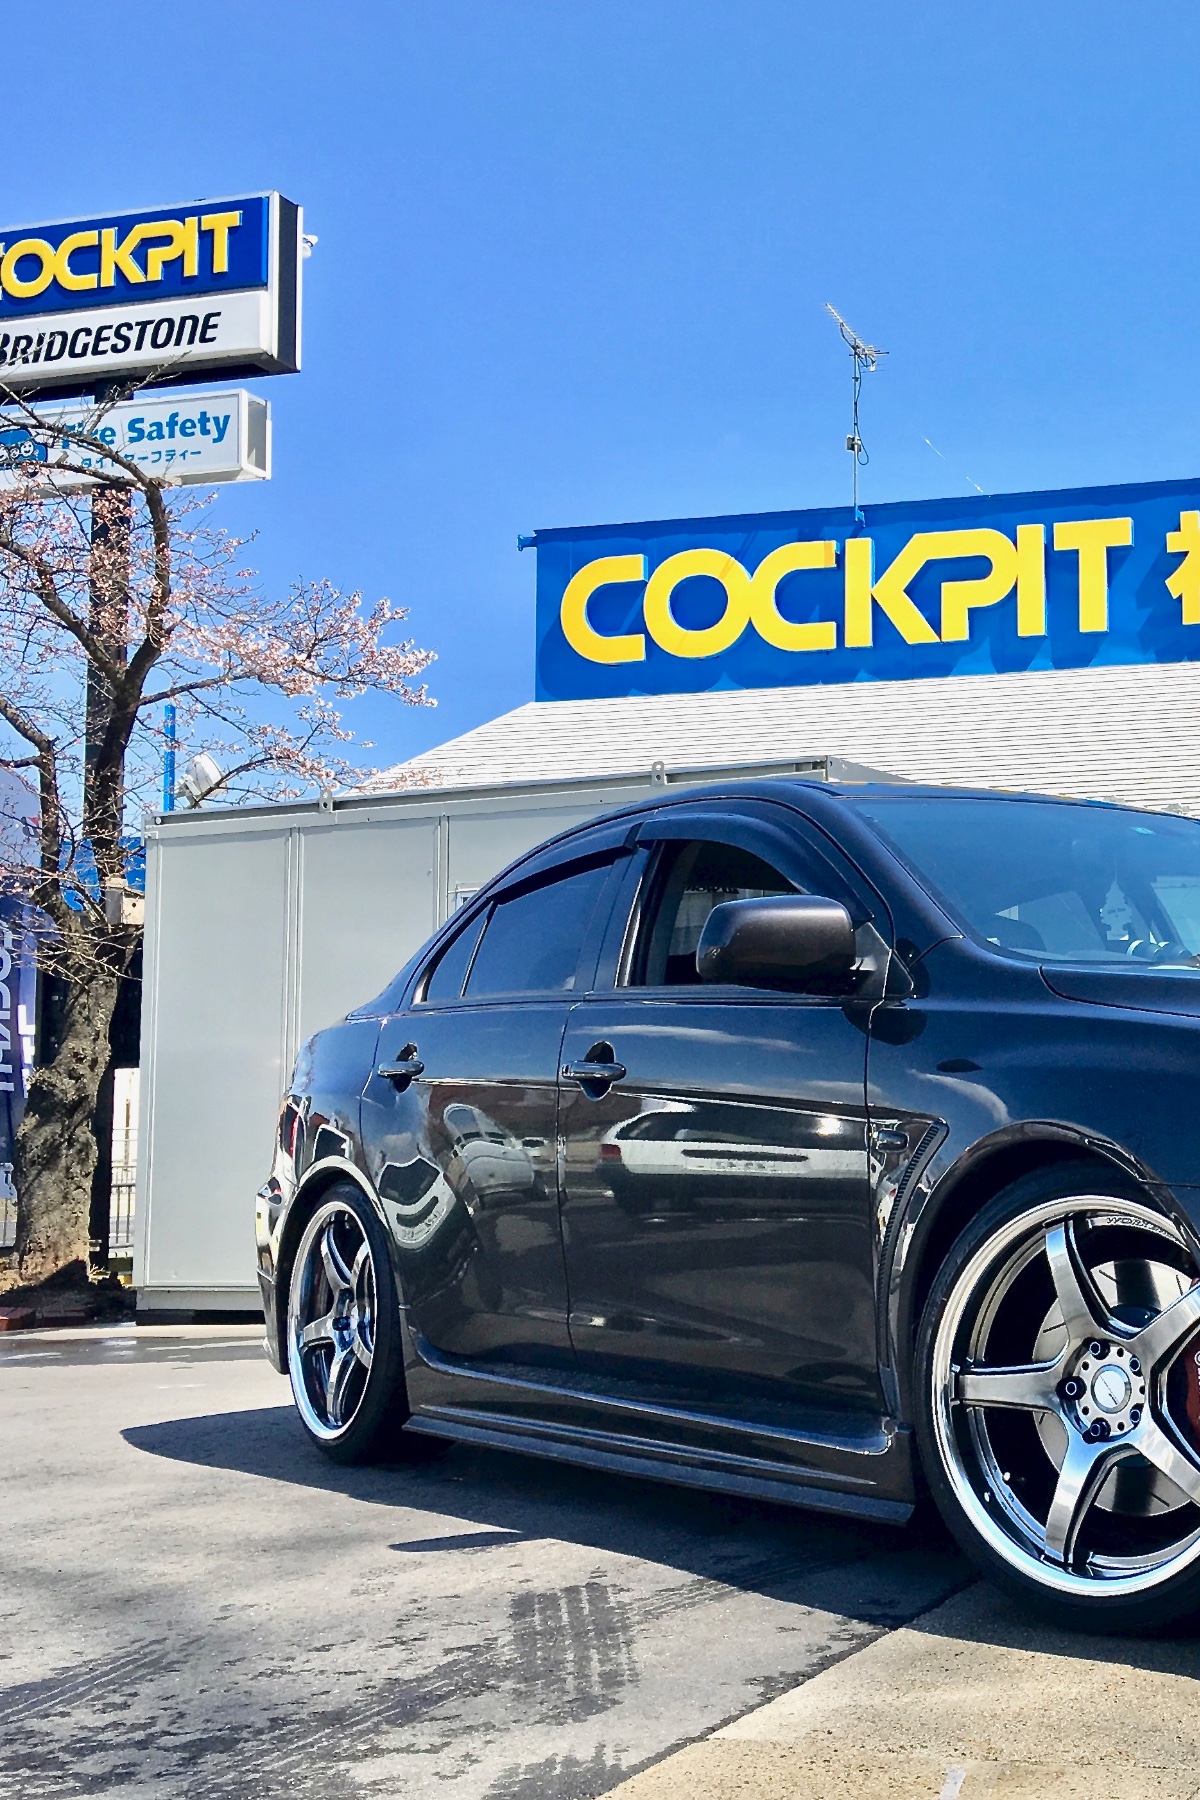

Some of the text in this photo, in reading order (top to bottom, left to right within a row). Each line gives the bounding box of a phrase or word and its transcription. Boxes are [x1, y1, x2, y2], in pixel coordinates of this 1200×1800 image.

[0, 211, 242, 298] OCKPIT
[62, 411, 230, 449] Te Safety
[81, 449, 202, 469] タイセーフティー
[560, 517, 1134, 664] COCKPIT
